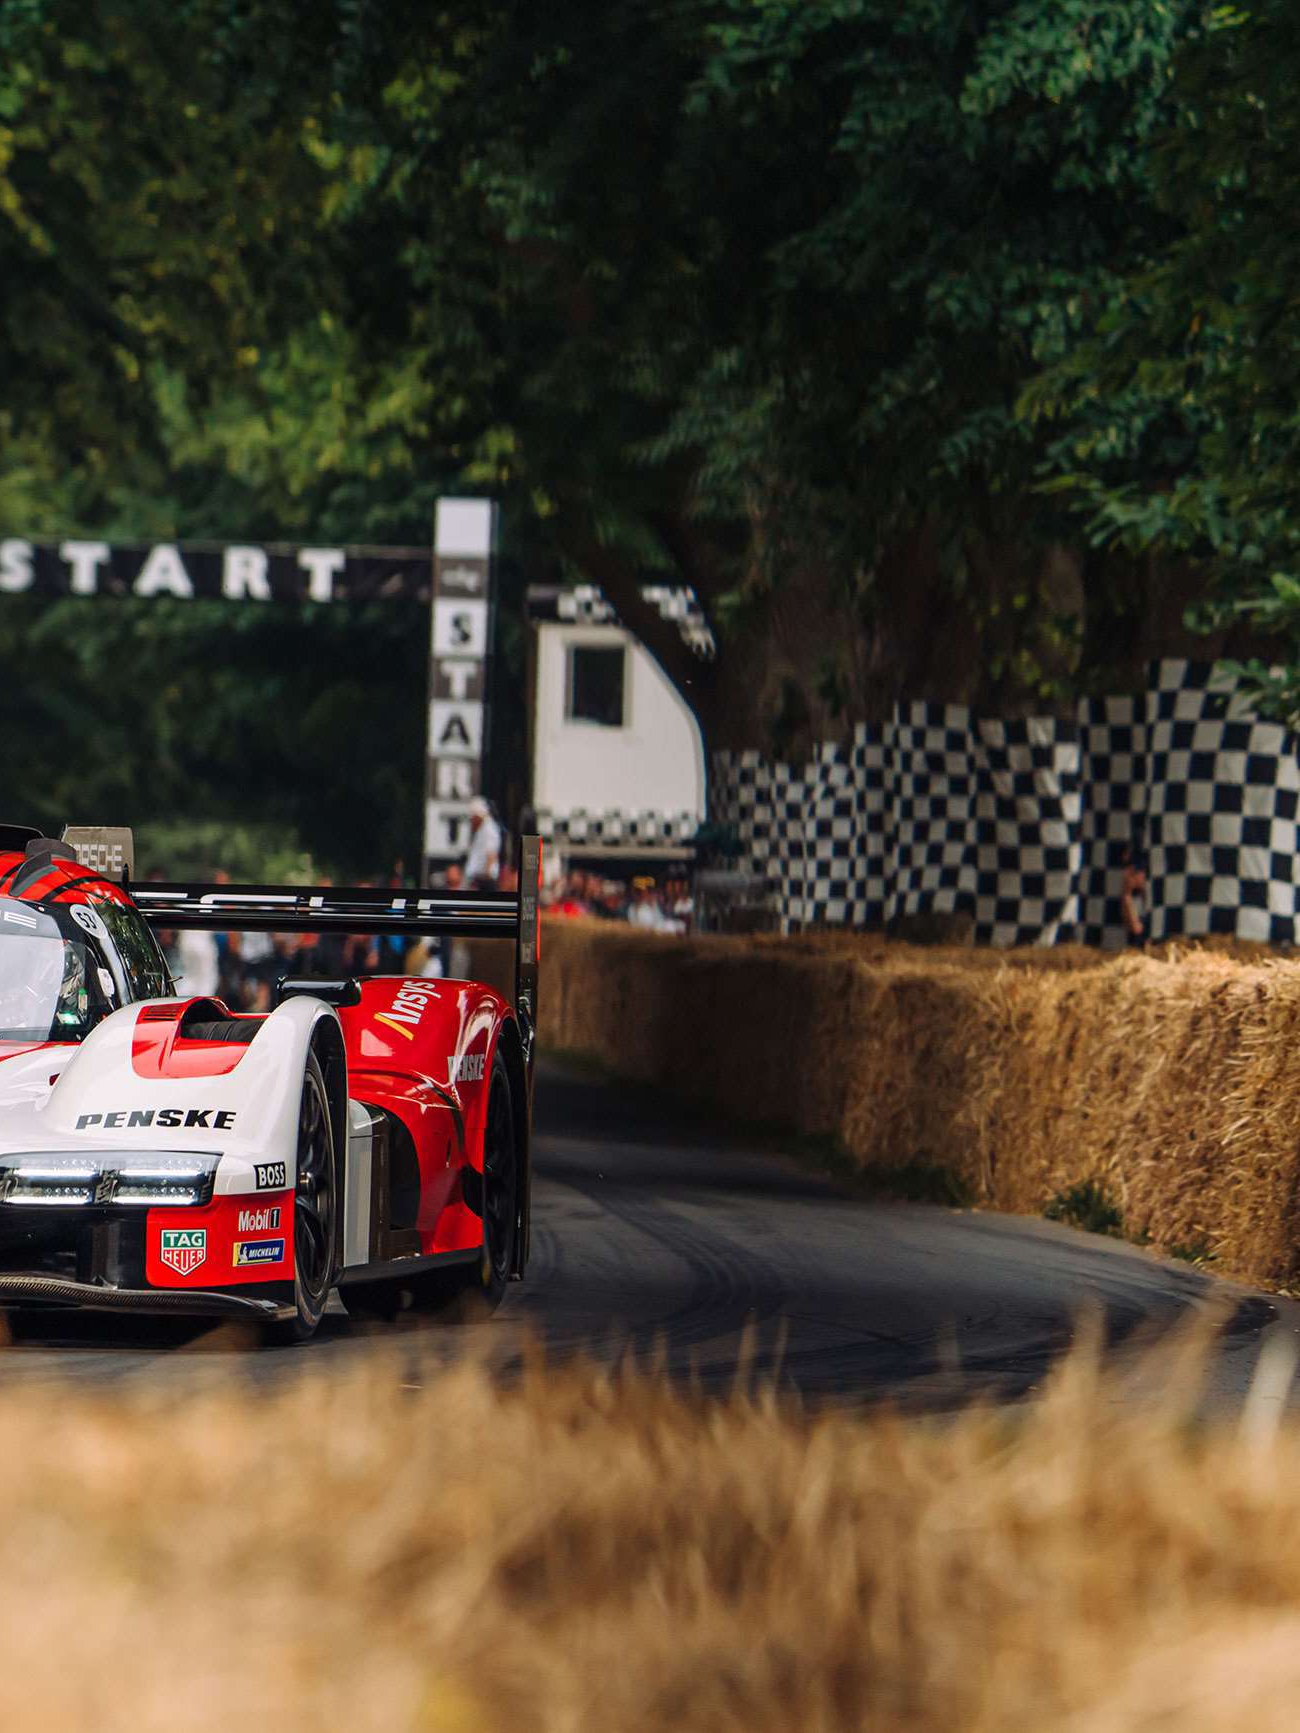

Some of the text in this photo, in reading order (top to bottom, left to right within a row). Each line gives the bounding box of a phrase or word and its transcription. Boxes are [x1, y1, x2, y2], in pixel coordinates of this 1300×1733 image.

[436, 611, 478, 846] START
[374, 981, 442, 1041] Ansys
[75, 1109, 237, 1130] PENSKE
[257, 1164, 285, 1186] BOSS
[238, 1208, 270, 1232] Mobil
[165, 1232, 203, 1247] TAG
[164, 1250, 204, 1272] HEUER
[248, 1247, 280, 1258] MICHELIN
